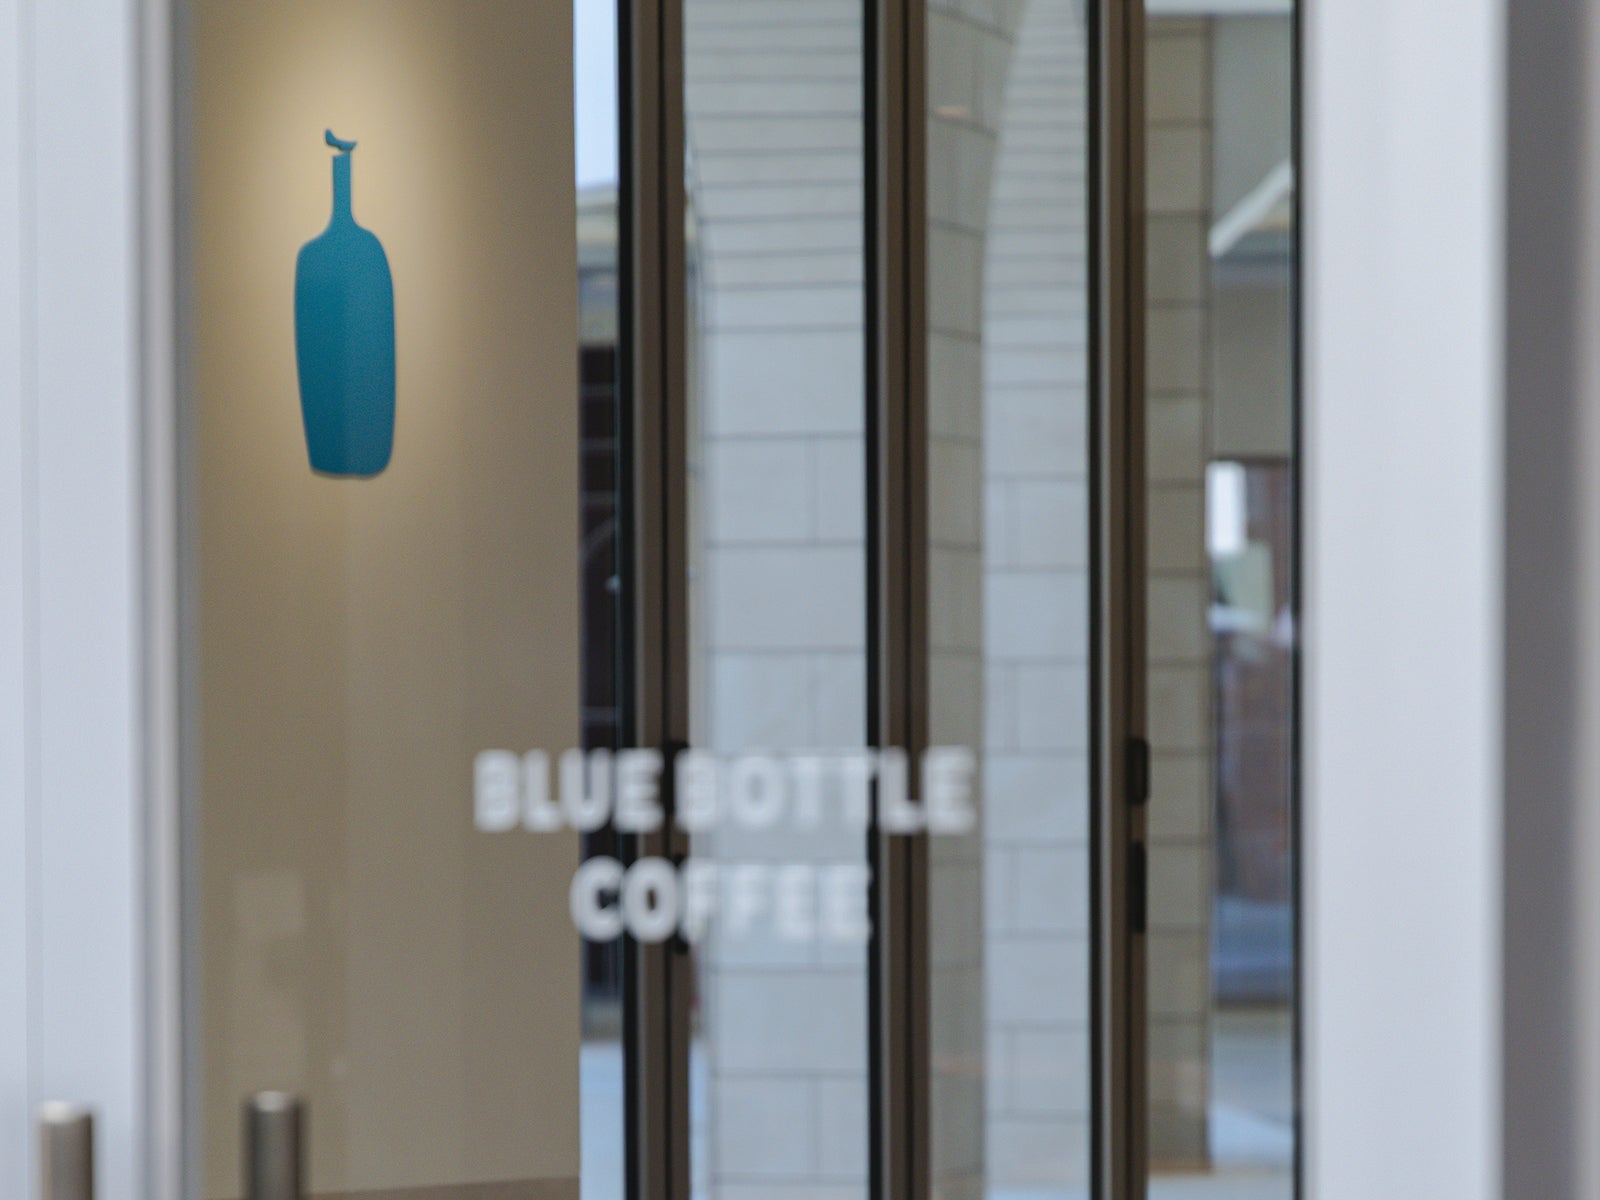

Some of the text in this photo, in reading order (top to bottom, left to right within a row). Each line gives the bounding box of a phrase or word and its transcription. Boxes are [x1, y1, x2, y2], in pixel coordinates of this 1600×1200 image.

[474, 747, 976, 835] BLUE BOTTLE
[569, 855, 873, 943] COFFEE
